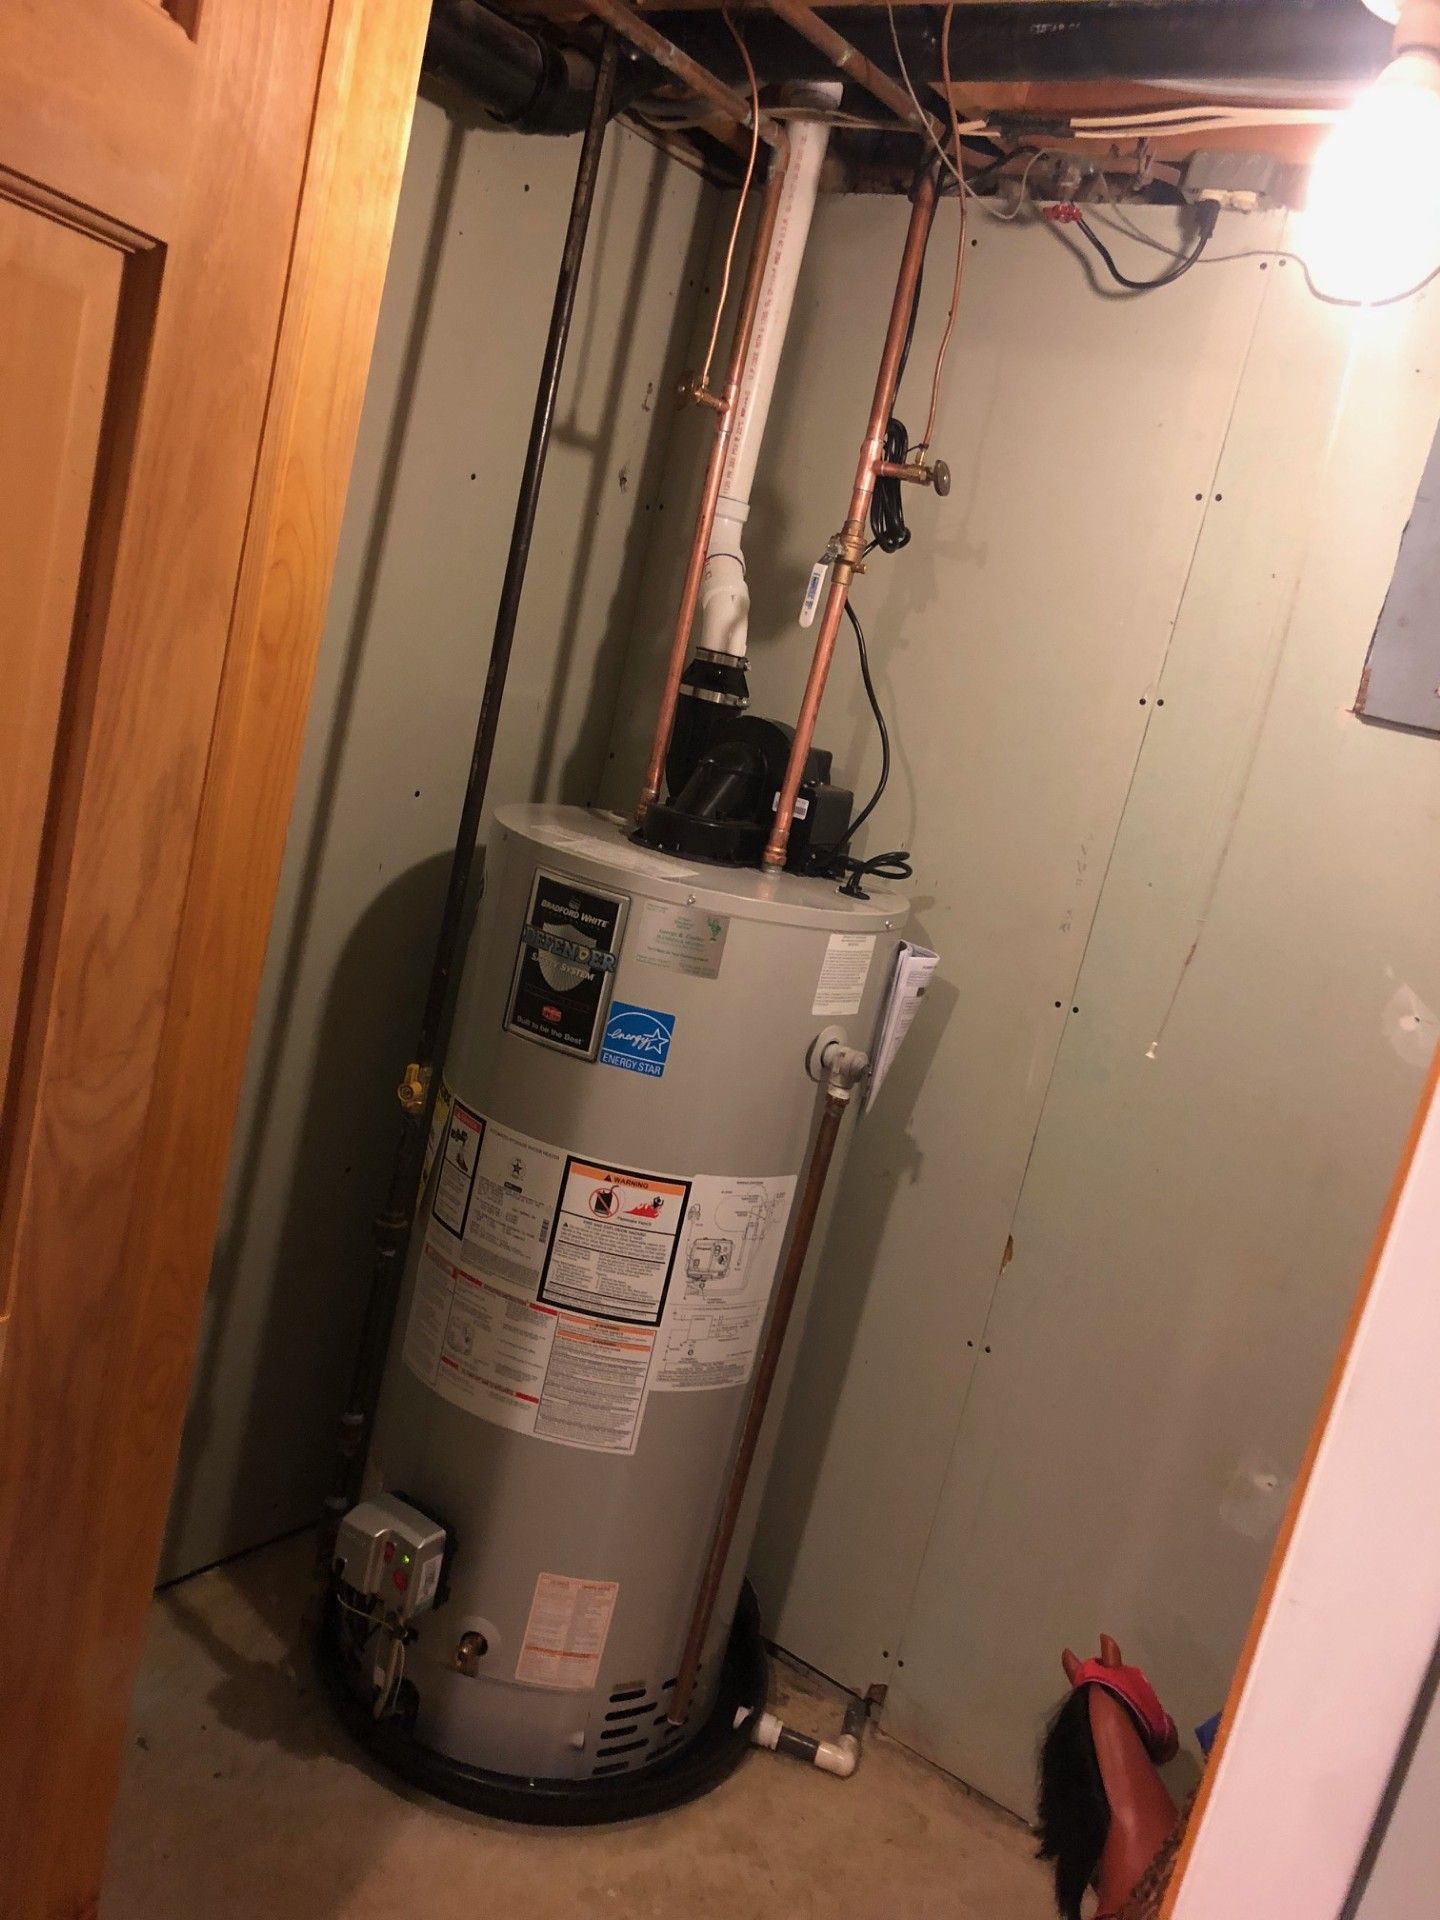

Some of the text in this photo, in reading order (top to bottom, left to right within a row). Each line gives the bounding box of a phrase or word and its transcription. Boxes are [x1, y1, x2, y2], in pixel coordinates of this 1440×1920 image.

[541, 899, 609, 928] BRADFORD WHITE
[523, 926, 615, 973] DEFENDER
[560, 963, 596, 981] SYSTEM
[540, 1024, 550, 1034] be
[551, 1028, 562, 1039] the
[564, 1033, 582, 1045] Best
[602, 1052, 661, 1076] ENERGY STAR
[613, 1176, 649, 1190] WARNING
